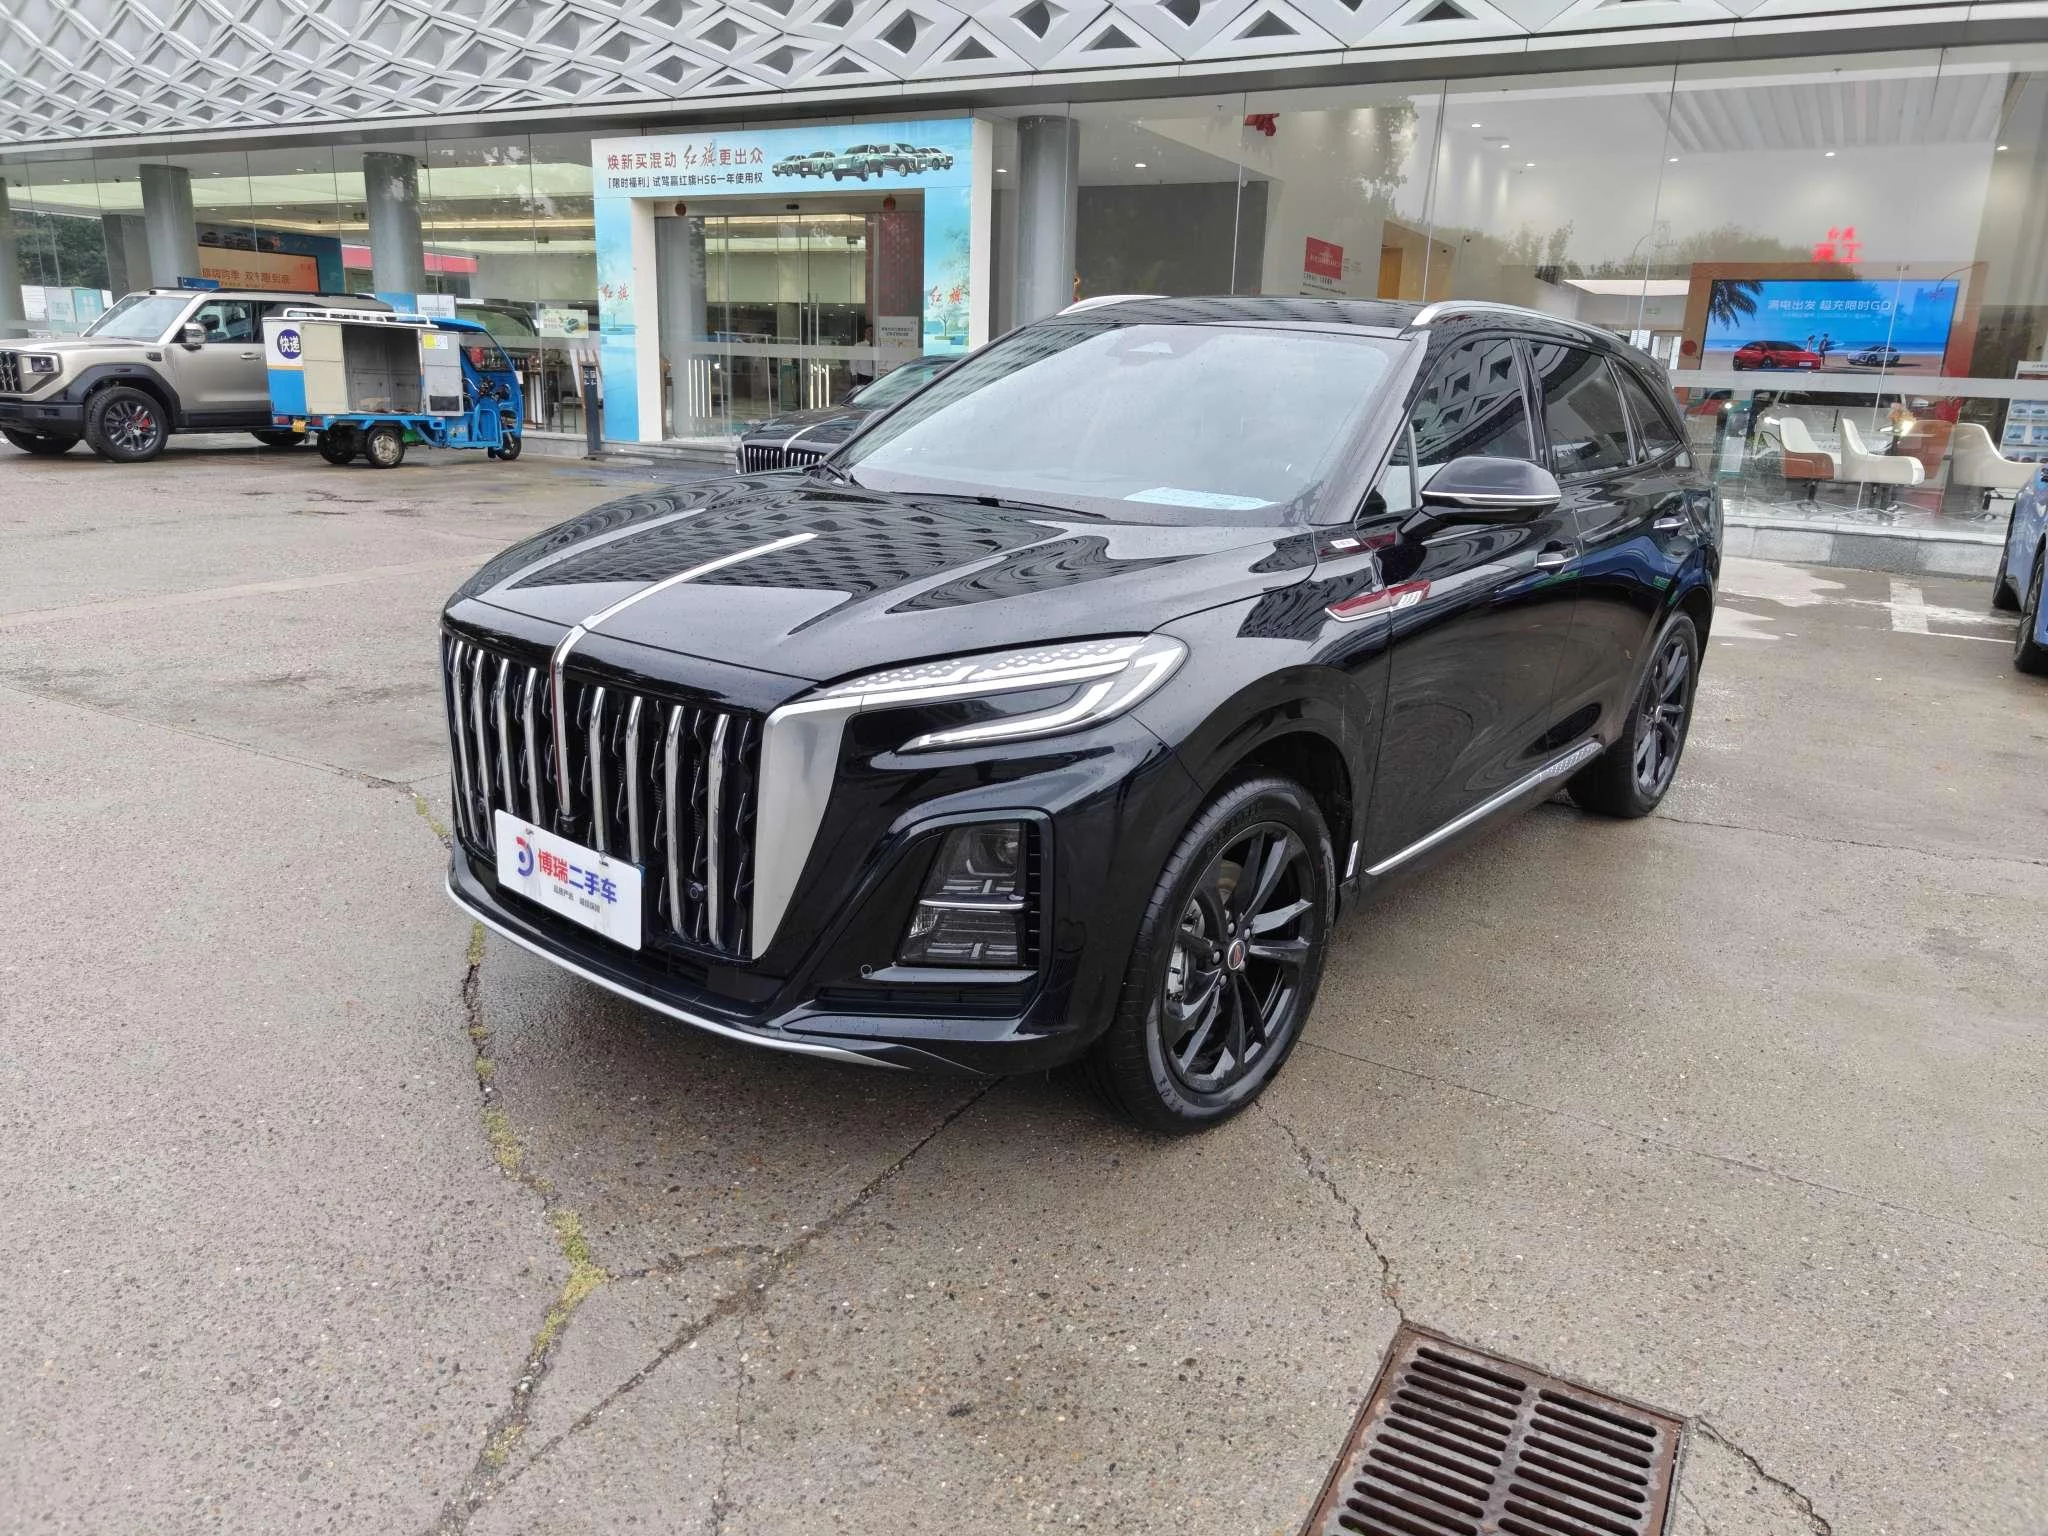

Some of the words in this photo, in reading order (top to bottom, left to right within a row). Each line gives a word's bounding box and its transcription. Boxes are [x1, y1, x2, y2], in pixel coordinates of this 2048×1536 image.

[608, 151, 677, 170] 焕新买混动
[683, 142, 764, 169] 红旗更出众
[279, 334, 301, 353] 快递
[538, 848, 618, 904] 博瑞二手车
